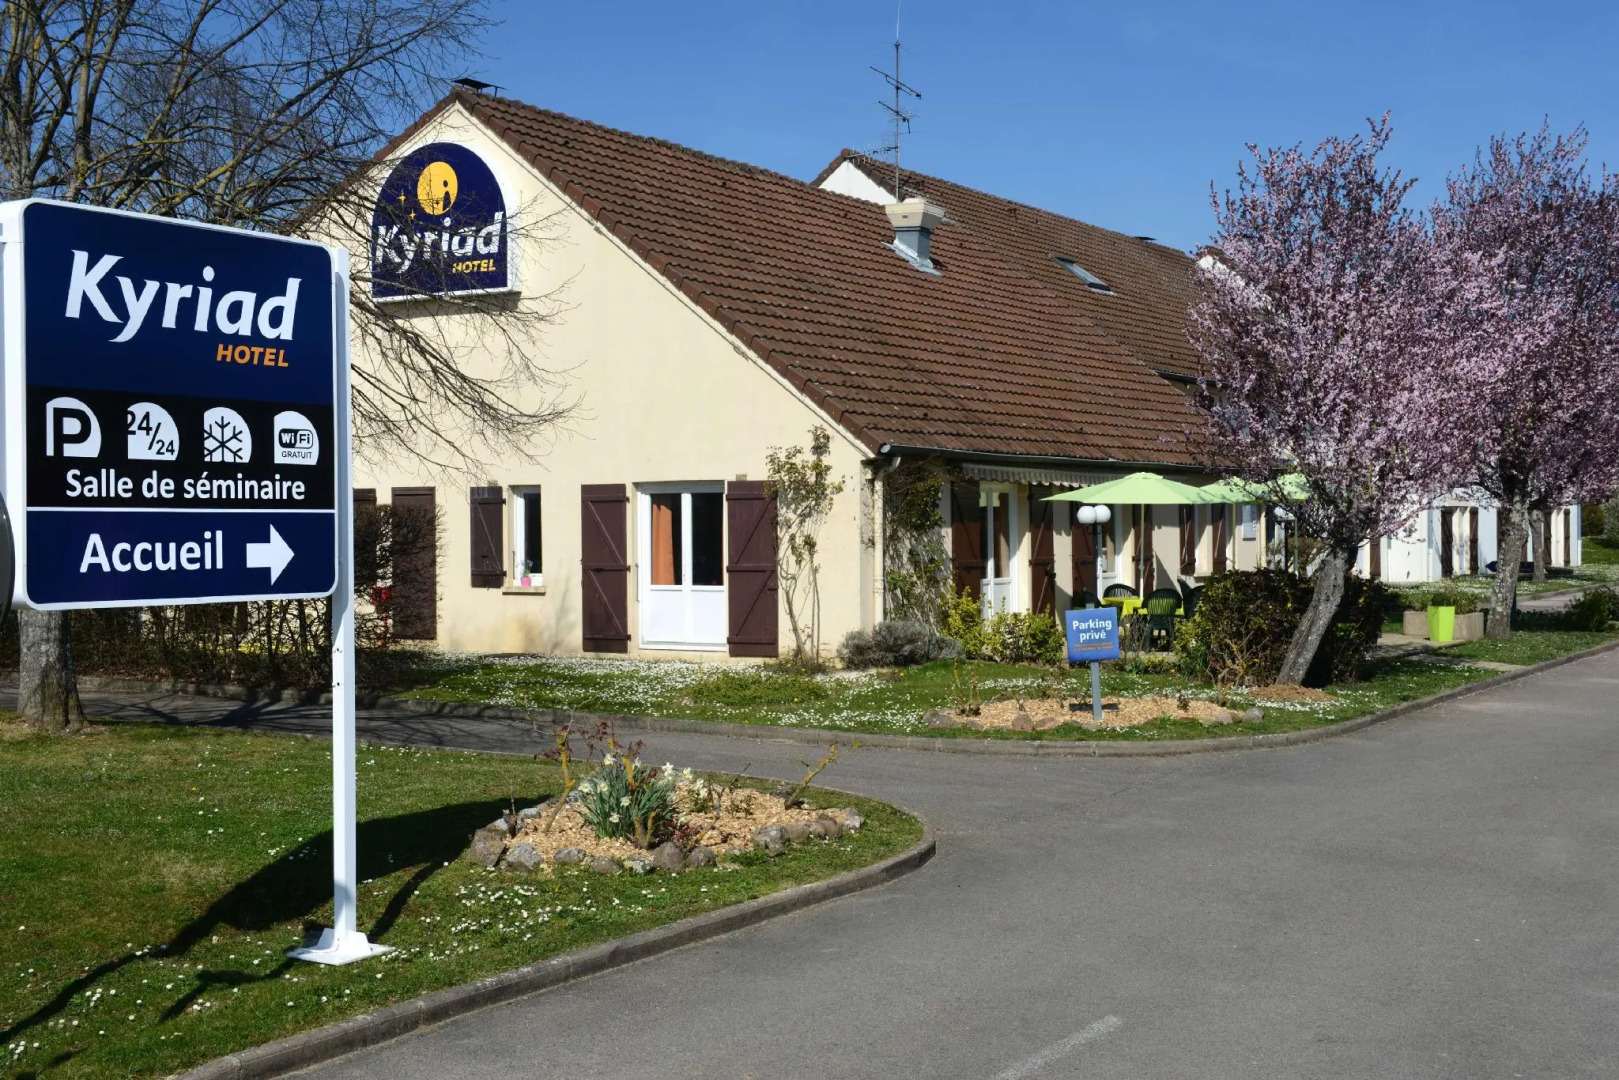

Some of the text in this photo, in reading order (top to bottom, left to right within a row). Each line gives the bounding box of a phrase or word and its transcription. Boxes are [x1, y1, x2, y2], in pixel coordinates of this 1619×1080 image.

[375, 211, 504, 273] Kyriad
[452, 259, 496, 273] HOTEL
[65, 249, 302, 342] Kyriad
[216, 343, 289, 367] HOTEL
[281, 450, 313, 459] GRATUIT
[65, 469, 306, 500] Salle de séminaire
[80, 530, 224, 573] Accueil
[1072, 618, 1112, 630] Parking
[1080, 630, 1106, 643] privé
